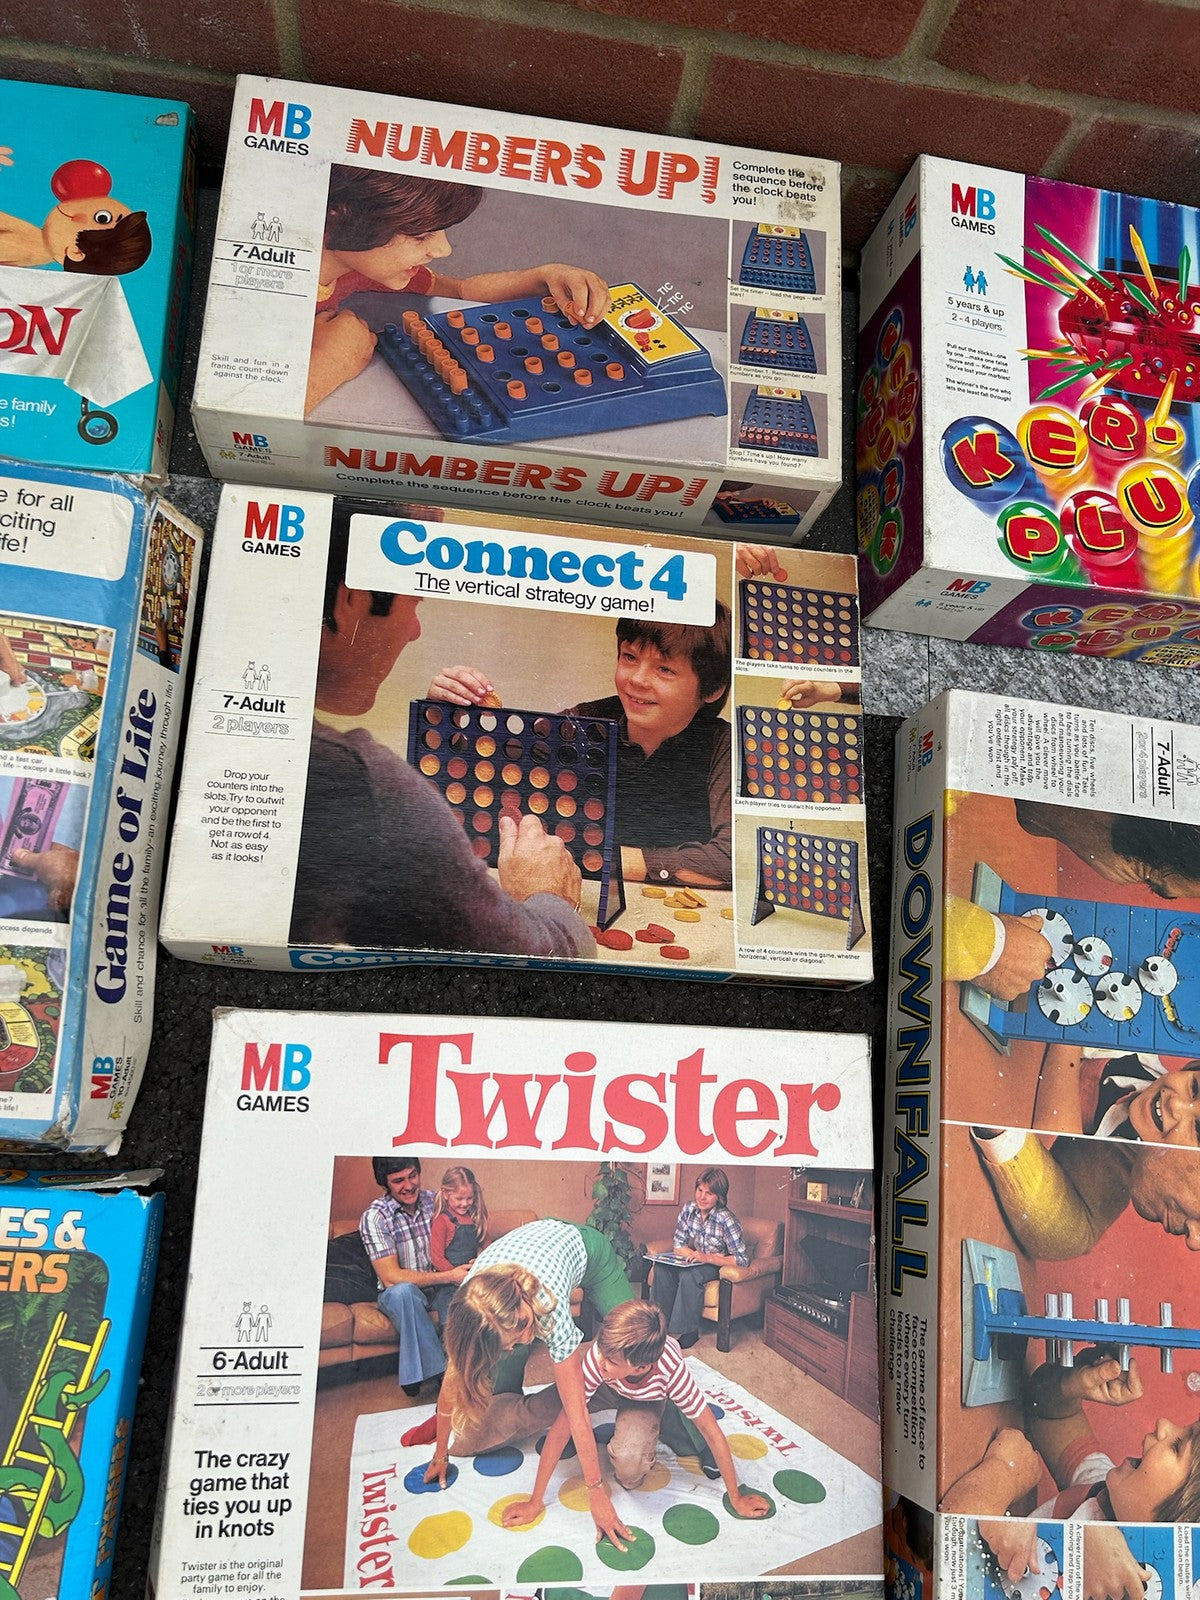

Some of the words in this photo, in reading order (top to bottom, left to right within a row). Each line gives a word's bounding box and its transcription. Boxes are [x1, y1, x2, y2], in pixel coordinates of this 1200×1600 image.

[247, 97, 313, 140] MB
[243, 135, 310, 156] GAMES
[345, 117, 607, 190] NUMBERS
[616, 147, 721, 205] UP!
[732, 160, 787, 178] Complete
[787, 167, 806, 179] the
[732, 172, 787, 191] sequence
[788, 178, 824, 193] before
[732, 183, 751, 194] the
[753, 185, 784, 199] clock
[786, 190, 817, 203] beats
[732, 195, 757, 207] you!
[950, 183, 997, 221] MB
[950, 216, 996, 236] GAMES
[232, 243, 296, 266] 7-Adult
[656, 281, 675, 296] TIC
[667, 291, 684, 306] TIC
[677, 301, 694, 315] TIC
[947, 295, 955, 305] 5
[956, 299, 982, 315] years
[983, 303, 991, 314] &
[992, 307, 1006, 318] up
[11, 396, 57, 416] family
[232, 431, 270, 448] MB
[323, 445, 587, 493] NUMBERS
[596, 469, 709, 508] UP!
[17, 488, 45, 506] for
[50, 494, 74, 512] all
[336, 473, 404, 488] Complete
[406, 479, 430, 491] the
[432, 482, 500, 500] sequence
[502, 489, 547, 503] before
[550, 493, 572, 505] the
[575, 497, 612, 510] clock
[615, 502, 652, 514] beats
[653, 508, 684, 519] you!
[244, 500, 306, 544] MB
[0, 533, 28, 553] fe!
[241, 540, 302, 558] GAMES
[380, 520, 644, 591] Connect
[649, 554, 688, 602] 4
[414, 572, 451, 593] The
[455, 578, 521, 600] vertical
[525, 584, 597, 611] strategy
[600, 596, 656, 614] game!
[940, 590, 980, 600] GAMES
[945, 577, 993, 594] MB
[165, 679, 175, 700] life!
[223, 694, 286, 714] 7-Adult
[160, 702, 172, 740] through
[212, 714, 225, 730] 2
[226, 716, 290, 736] players
[120, 688, 157, 783] Life
[922, 730, 934, 767] MB
[154, 740, 168, 780] journey
[1158, 742, 1171, 796] 7-Adult
[223, 769, 248, 781] Drop
[248, 772, 270, 782] your
[207, 781, 249, 792] counters
[249, 782, 268, 792] into
[269, 784, 284, 794] the
[150, 781, 163, 824] exciting
[204, 792, 229, 802] slots.
[229, 793, 244, 804] Try
[245, 794, 255, 803] to
[256, 795, 285, 806] outwit
[116, 785, 144, 843] of
[209, 805, 231, 815] your
[231, 806, 278, 817] opponent
[201, 815, 220, 826] and
[221, 816, 235, 826] be
[235, 817, 251, 827] the
[252, 818, 270, 829] first
[272, 820, 282, 829] to
[209, 829, 226, 840] get
[226, 831, 233, 839] a
[234, 831, 250, 840] row
[251, 830, 263, 840] of
[262, 830, 272, 841] 4.
[210, 839, 229, 850] Not
[230, 841, 243, 851] as
[244, 842, 269, 853] easy
[211, 853, 224, 862] as
[225, 853, 232, 863] it
[233, 853, 264, 864] looks!
[141, 876, 150, 895] the
[140, 896, 149, 910] all
[94, 852, 135, 1004] Game
[138, 912, 147, 926] for
[136, 930, 146, 971] chance
[136, 975, 144, 997] and
[134, 1000, 143, 1024] Skill
[891, 810, 936, 1298] DOWNFALL
[90, 1056, 116, 1099] MB
[109, 1056, 123, 1099] GAMES
[240, 1042, 312, 1092] MB
[236, 1094, 310, 1113] GAMES
[378, 1032, 842, 1159] Twister
[54, 1210, 87, 1250] &
[919, 1318, 927, 1346] The
[888, 1309, 896, 1380] challenge
[212, 1351, 289, 1371] 6-Adult
[896, 1353, 903, 1366] to
[896, 1370, 901, 1379] a
[918, 1349, 926, 1394] game
[910, 1351, 919, 1445] competition
[919, 1396, 926, 1413] of
[703, 1387, 802, 1457] Twister
[194, 1450, 232, 1468] The
[236, 1452, 290, 1470] crazy
[919, 1453, 925, 1470] to
[190, 1476, 247, 1496] game
[251, 1472, 290, 1490] that
[183, 1498, 219, 1515] ties
[224, 1500, 261, 1518] you
[267, 1498, 292, 1516] up
[195, 1521, 213, 1538] in
[218, 1519, 275, 1538] knots
[356, 1462, 400, 1589] Twister
[182, 1561, 217, 1571] Twister
[219, 1560, 228, 1570] is
[229, 1560, 245, 1570] the
[247, 1559, 284, 1571] original
[181, 1574, 206, 1584] party
[207, 1572, 235, 1583] game
[237, 1571, 250, 1581] for
[252, 1570, 264, 1580] all
[266, 1570, 282, 1580] the
[192, 1584, 223, 1595] family
[224, 1584, 235, 1593] to
[237, 1583, 266, 1594] enjoy.
